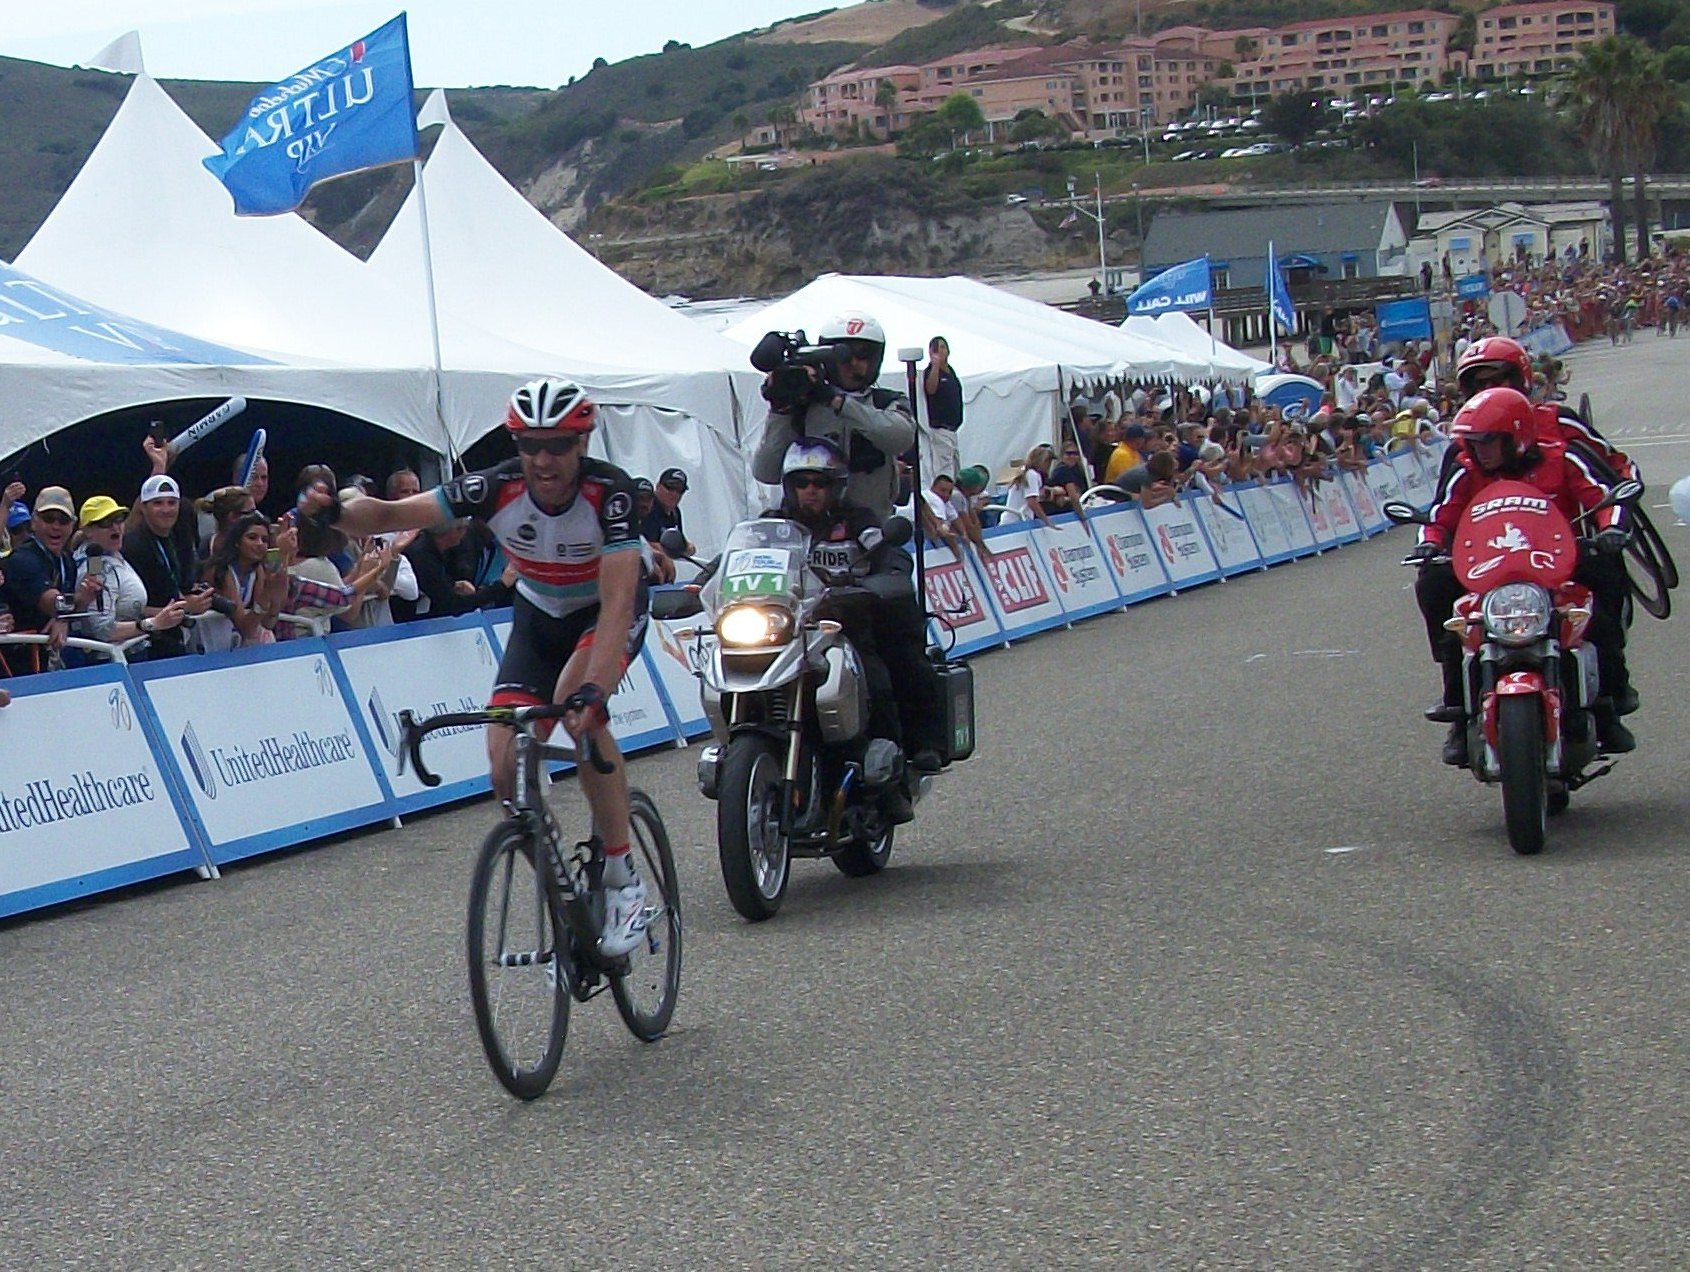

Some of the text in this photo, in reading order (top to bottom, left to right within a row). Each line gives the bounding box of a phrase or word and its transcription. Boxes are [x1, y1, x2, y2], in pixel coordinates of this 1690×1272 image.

[1470, 496, 1548, 517] SRAM
[729, 574, 763, 593] TV
[997, 554, 1041, 603] CLIF
[210, 731, 355, 787] UnitedHealthcare
